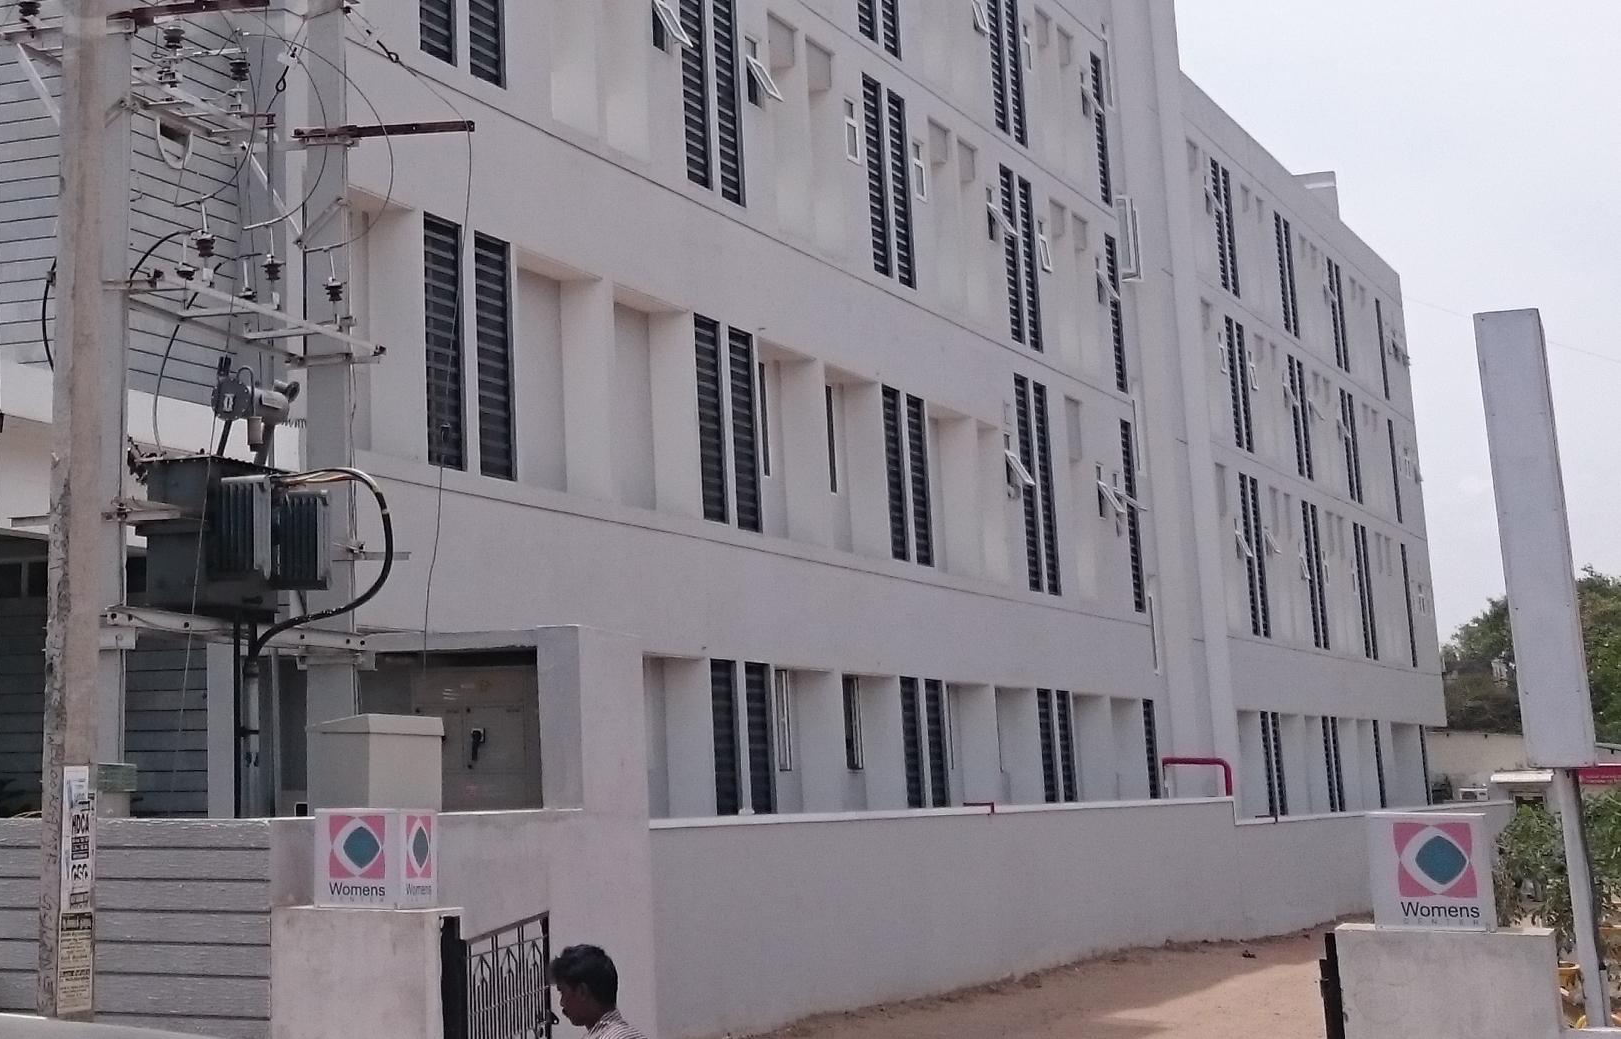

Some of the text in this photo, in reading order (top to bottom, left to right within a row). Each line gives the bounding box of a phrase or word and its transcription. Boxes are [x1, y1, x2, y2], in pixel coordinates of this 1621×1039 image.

[329, 882, 386, 897] Womens
[406, 883, 432, 896] Womens
[1400, 901, 1480, 919] Womens
